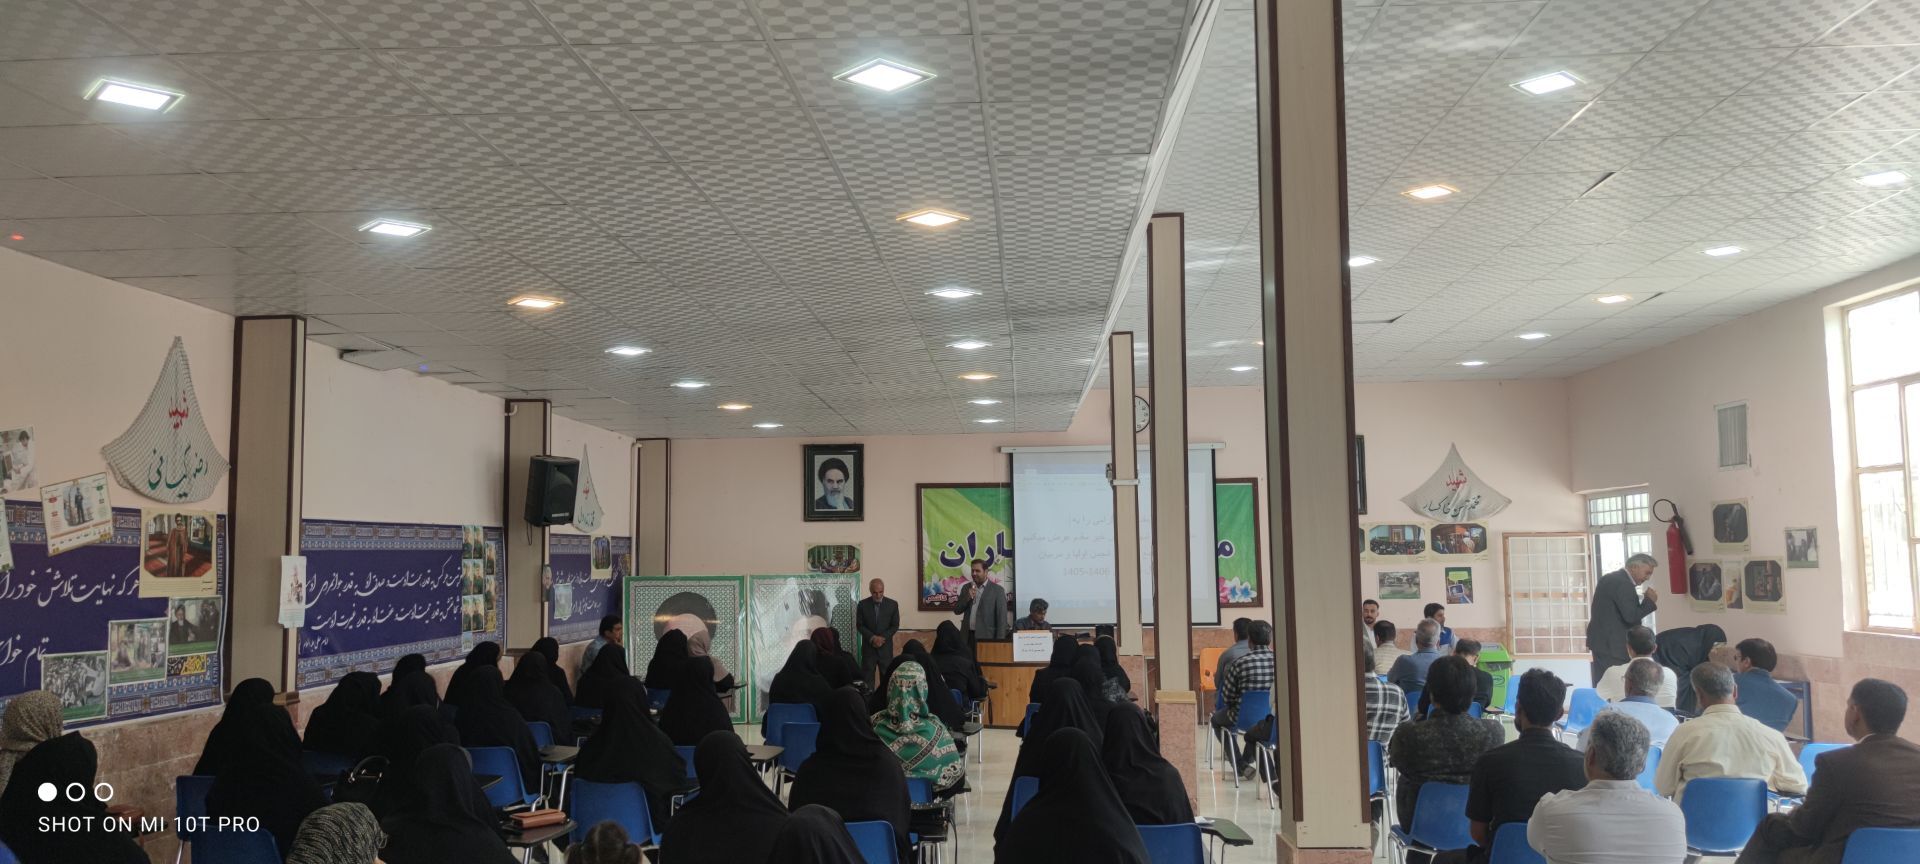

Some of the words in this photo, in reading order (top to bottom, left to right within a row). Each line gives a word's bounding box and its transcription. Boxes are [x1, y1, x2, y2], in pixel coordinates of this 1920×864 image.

[168, 389, 189, 429] شهید
[1446, 468, 1467, 492] شهید
[12, 569, 37, 600] خود
[37, 567, 79, 608] تلاش
[70, 573, 116, 606] نهایت
